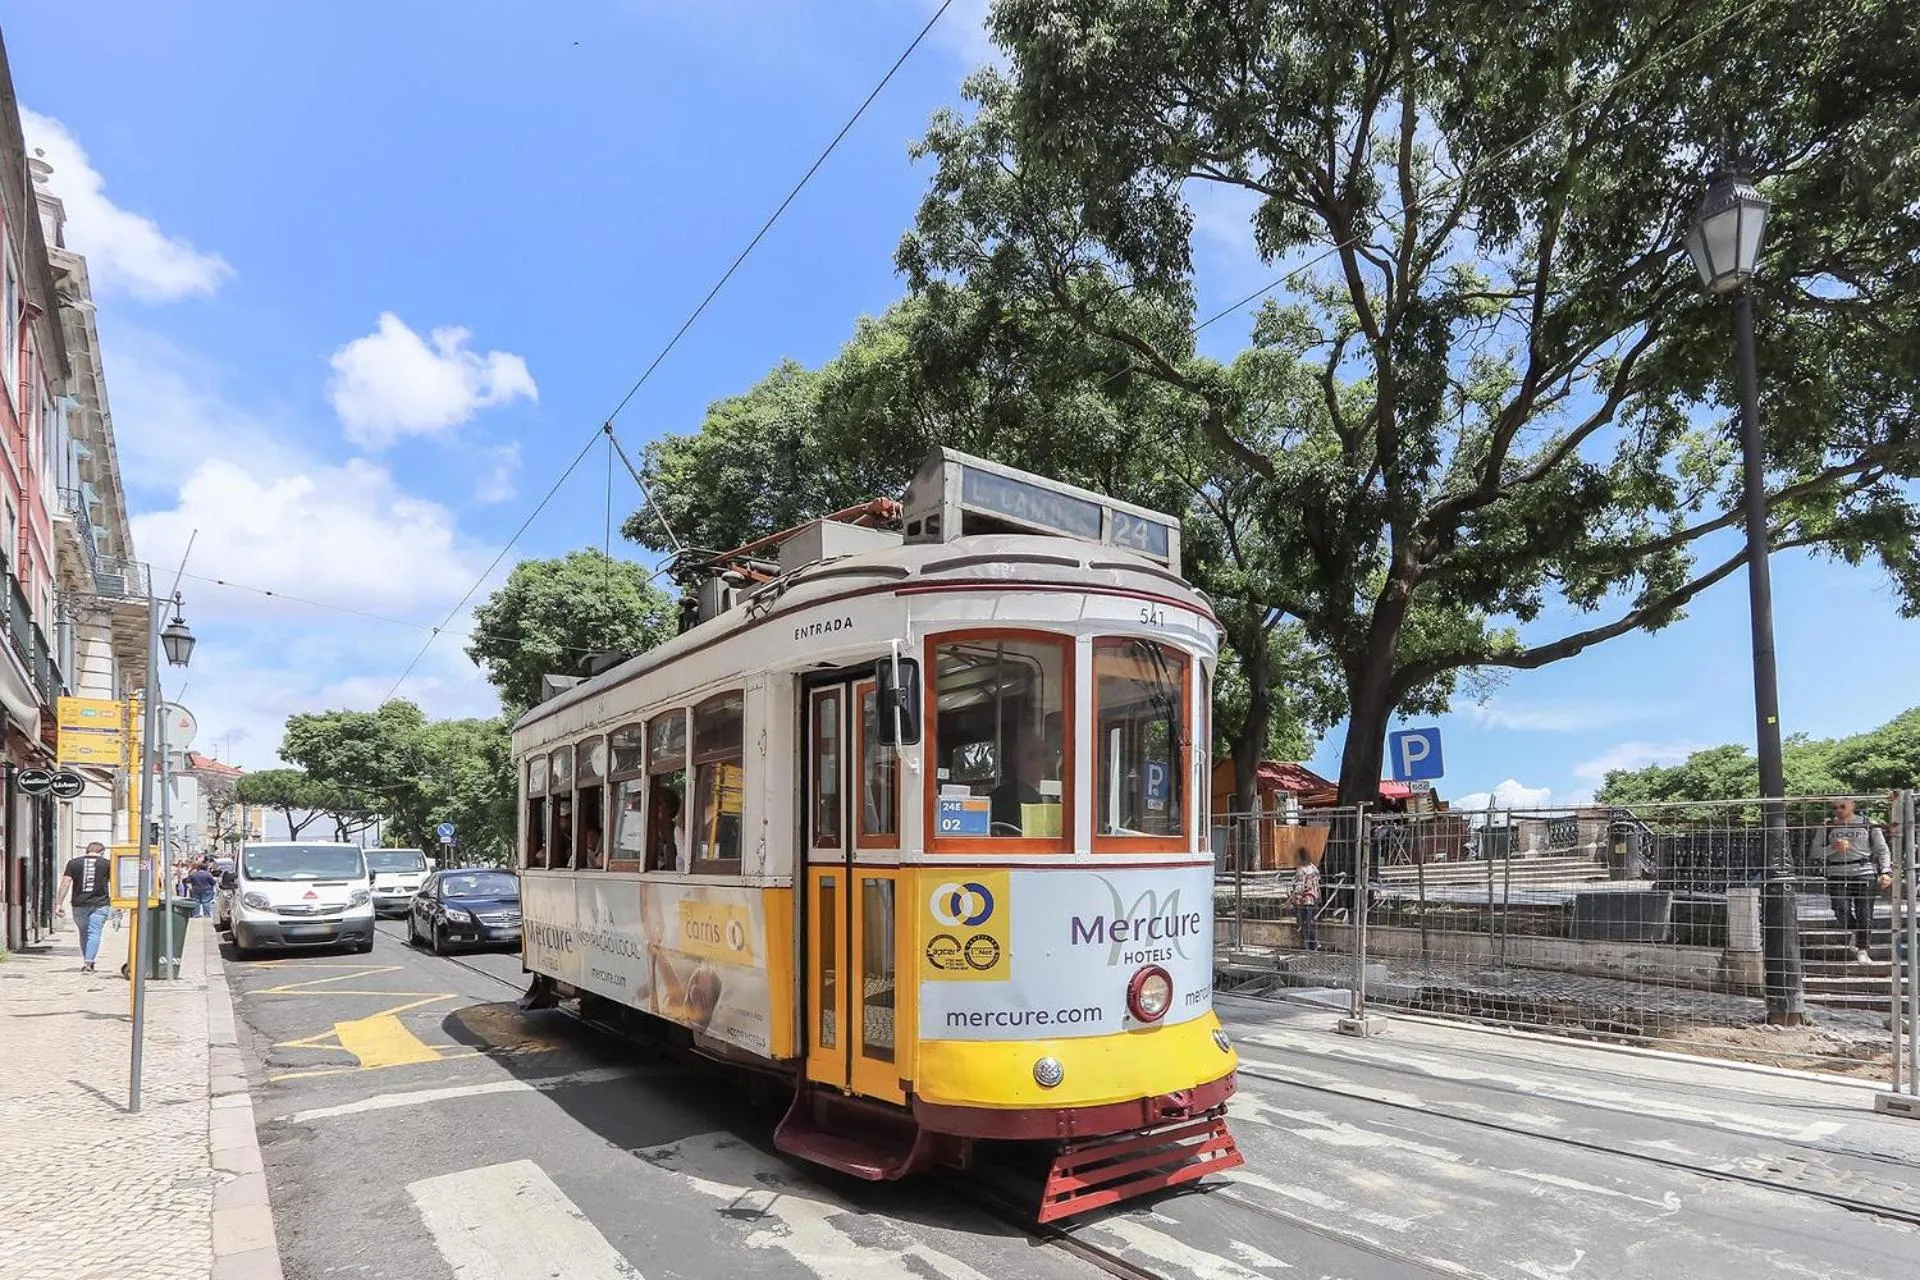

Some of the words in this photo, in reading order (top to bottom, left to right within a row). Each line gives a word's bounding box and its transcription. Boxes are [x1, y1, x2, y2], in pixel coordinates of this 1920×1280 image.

[1114, 513, 1149, 549] 24
[795, 616, 853, 640] ENTRADA
[1140, 607, 1164, 627] 541
[1401, 734, 1431, 777] P
[943, 802, 961, 811] 24E
[942, 818, 961, 831] 02
[525, 919, 573, 953] Mercure
[685, 915, 721, 944] carris
[1071, 912, 1201, 945] Mercure
[1124, 947, 1173, 965] HOTELS
[946, 1006, 1103, 1027] mercure.com
